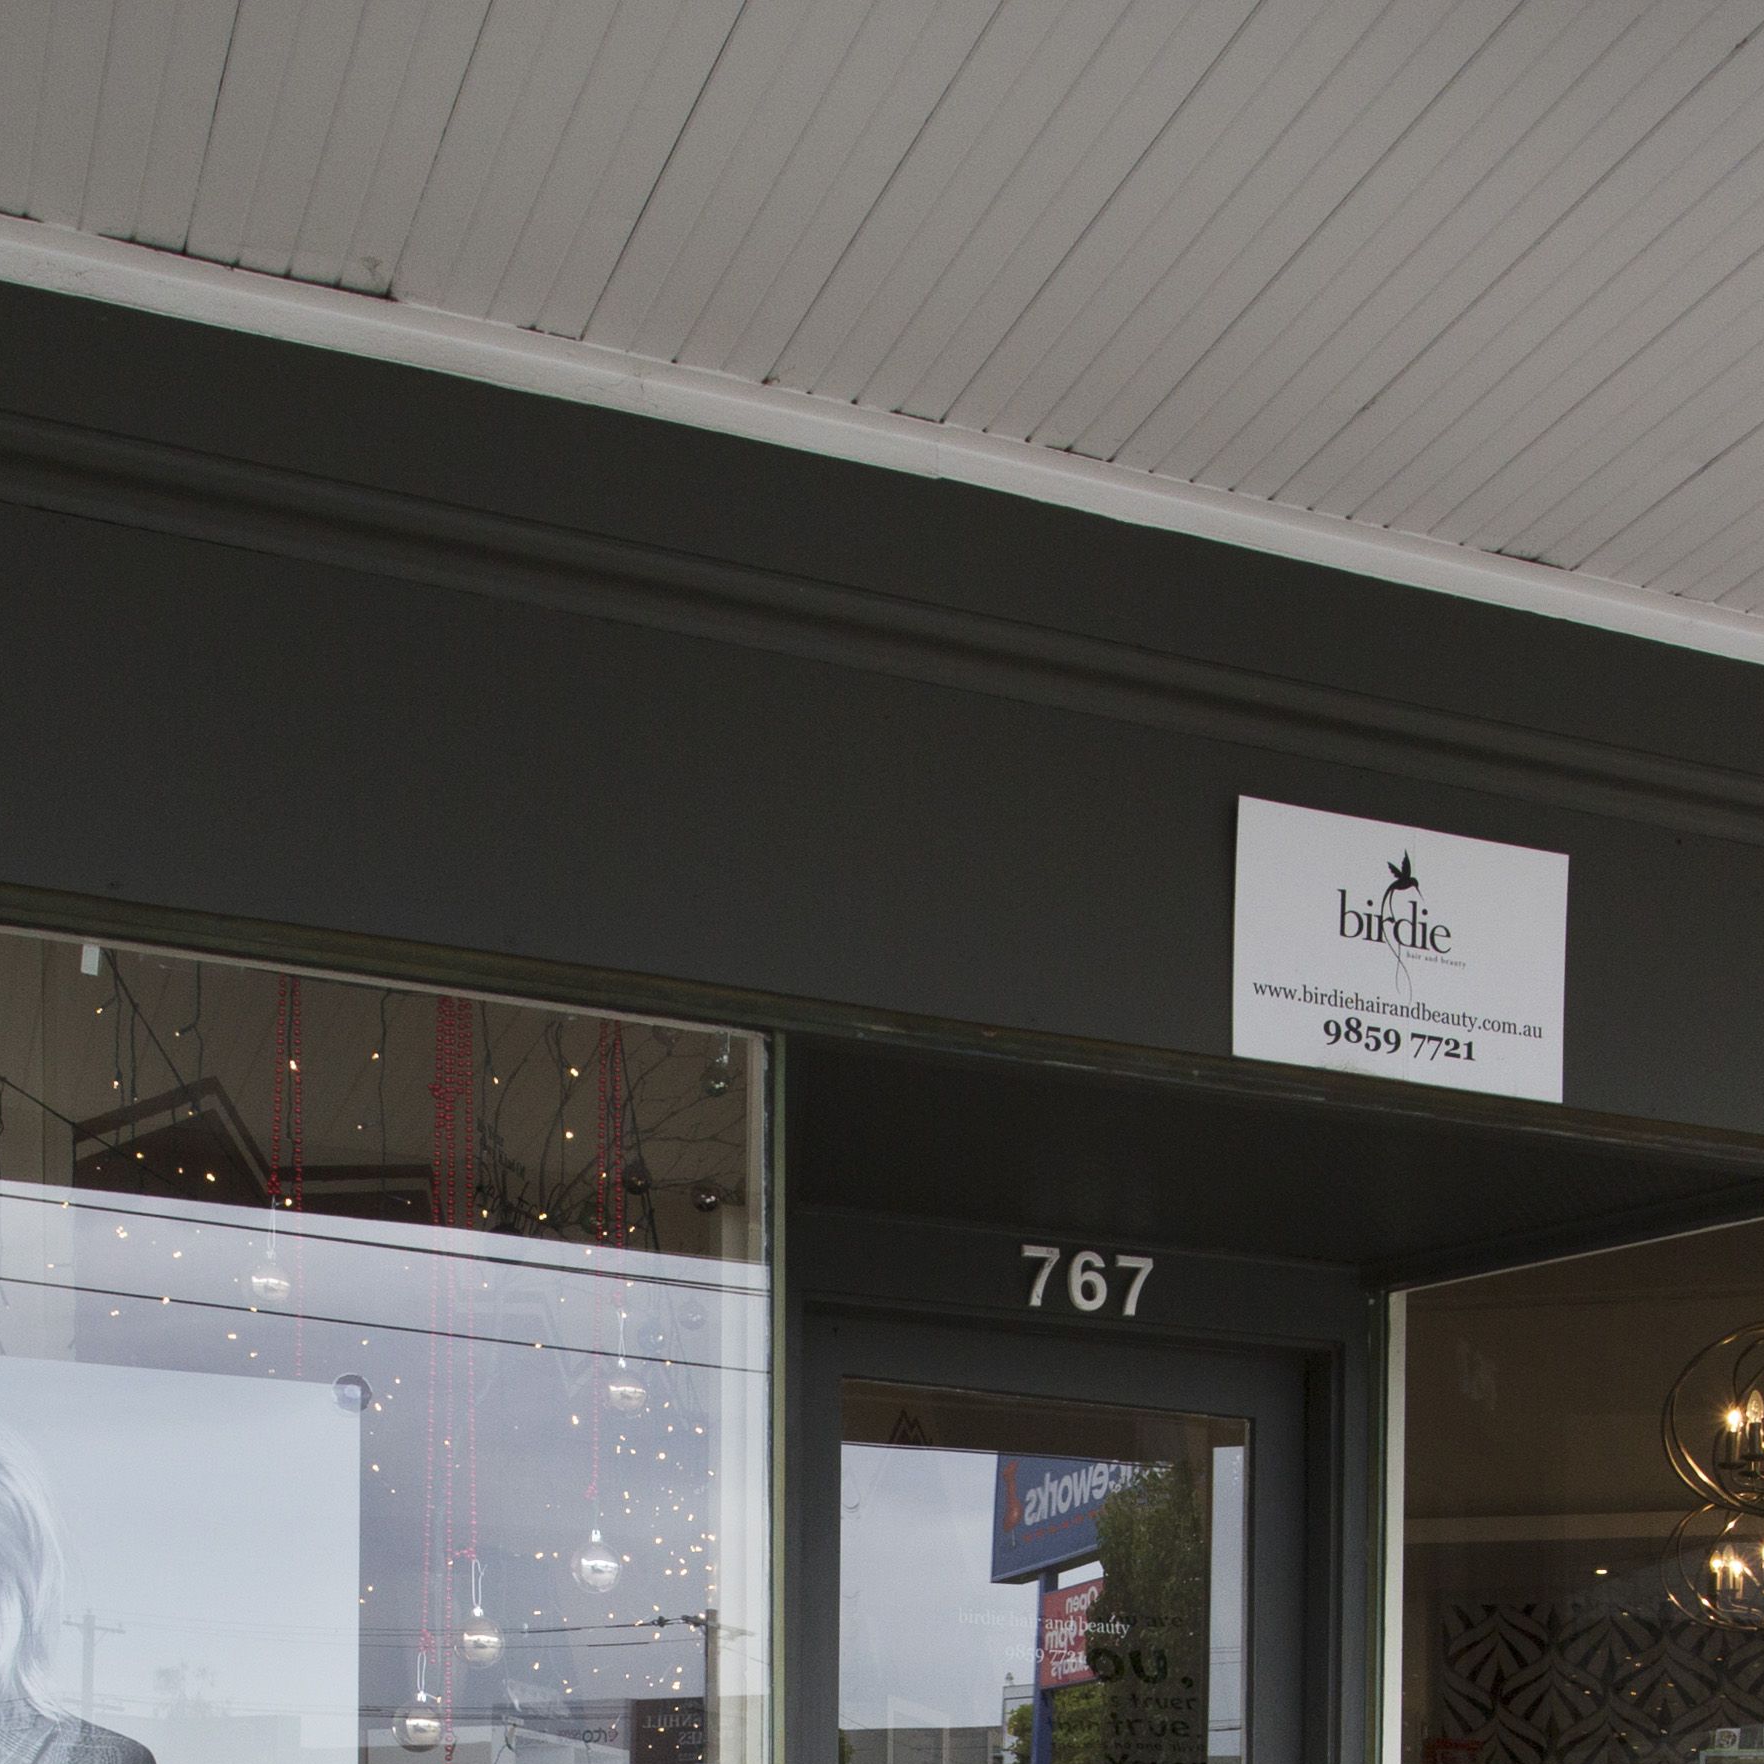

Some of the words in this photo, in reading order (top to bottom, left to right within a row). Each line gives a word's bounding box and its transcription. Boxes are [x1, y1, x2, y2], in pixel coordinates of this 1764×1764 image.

[1337, 888, 1452, 954] birdie
[1406, 951, 1422, 961] hair
[1425, 955, 1438, 963] and
[1441, 956, 1466, 969] beauty
[1253, 981, 1543, 1039] www.birdiehairandbeauty.com.au
[1324, 1017, 1401, 1055] 9859
[1410, 1032, 1476, 1061] 7721
[1021, 1244, 1154, 1316] 767
[1045, 1617, 1074, 1630] and
[1080, 1617, 1130, 1638] beauty
